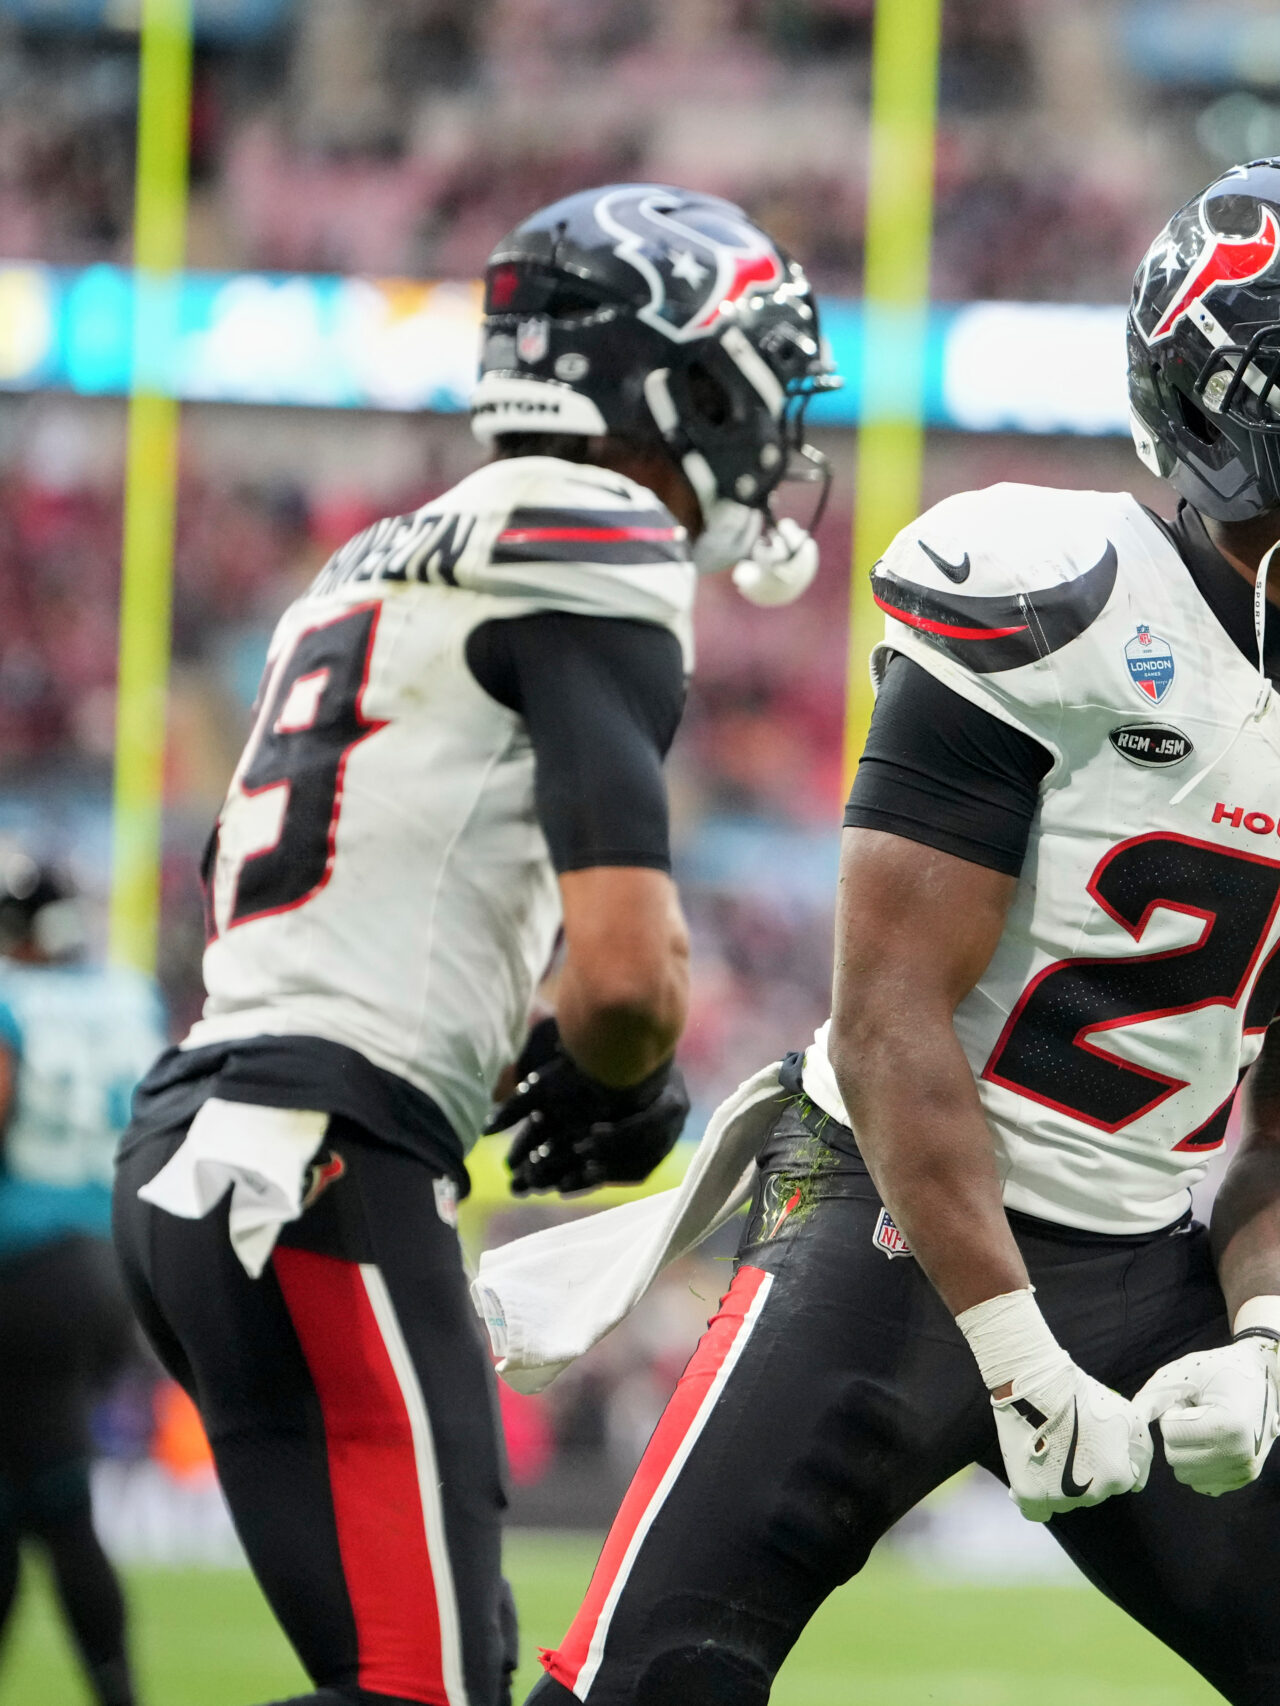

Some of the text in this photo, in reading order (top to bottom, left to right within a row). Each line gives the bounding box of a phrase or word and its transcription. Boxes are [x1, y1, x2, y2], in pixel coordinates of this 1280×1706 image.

[1130, 660, 1172, 672] LONDON
[1118, 732, 1185, 756] RCM JSM
[202, 600, 392, 944] 9
[881, 1226, 910, 1250] NFL
